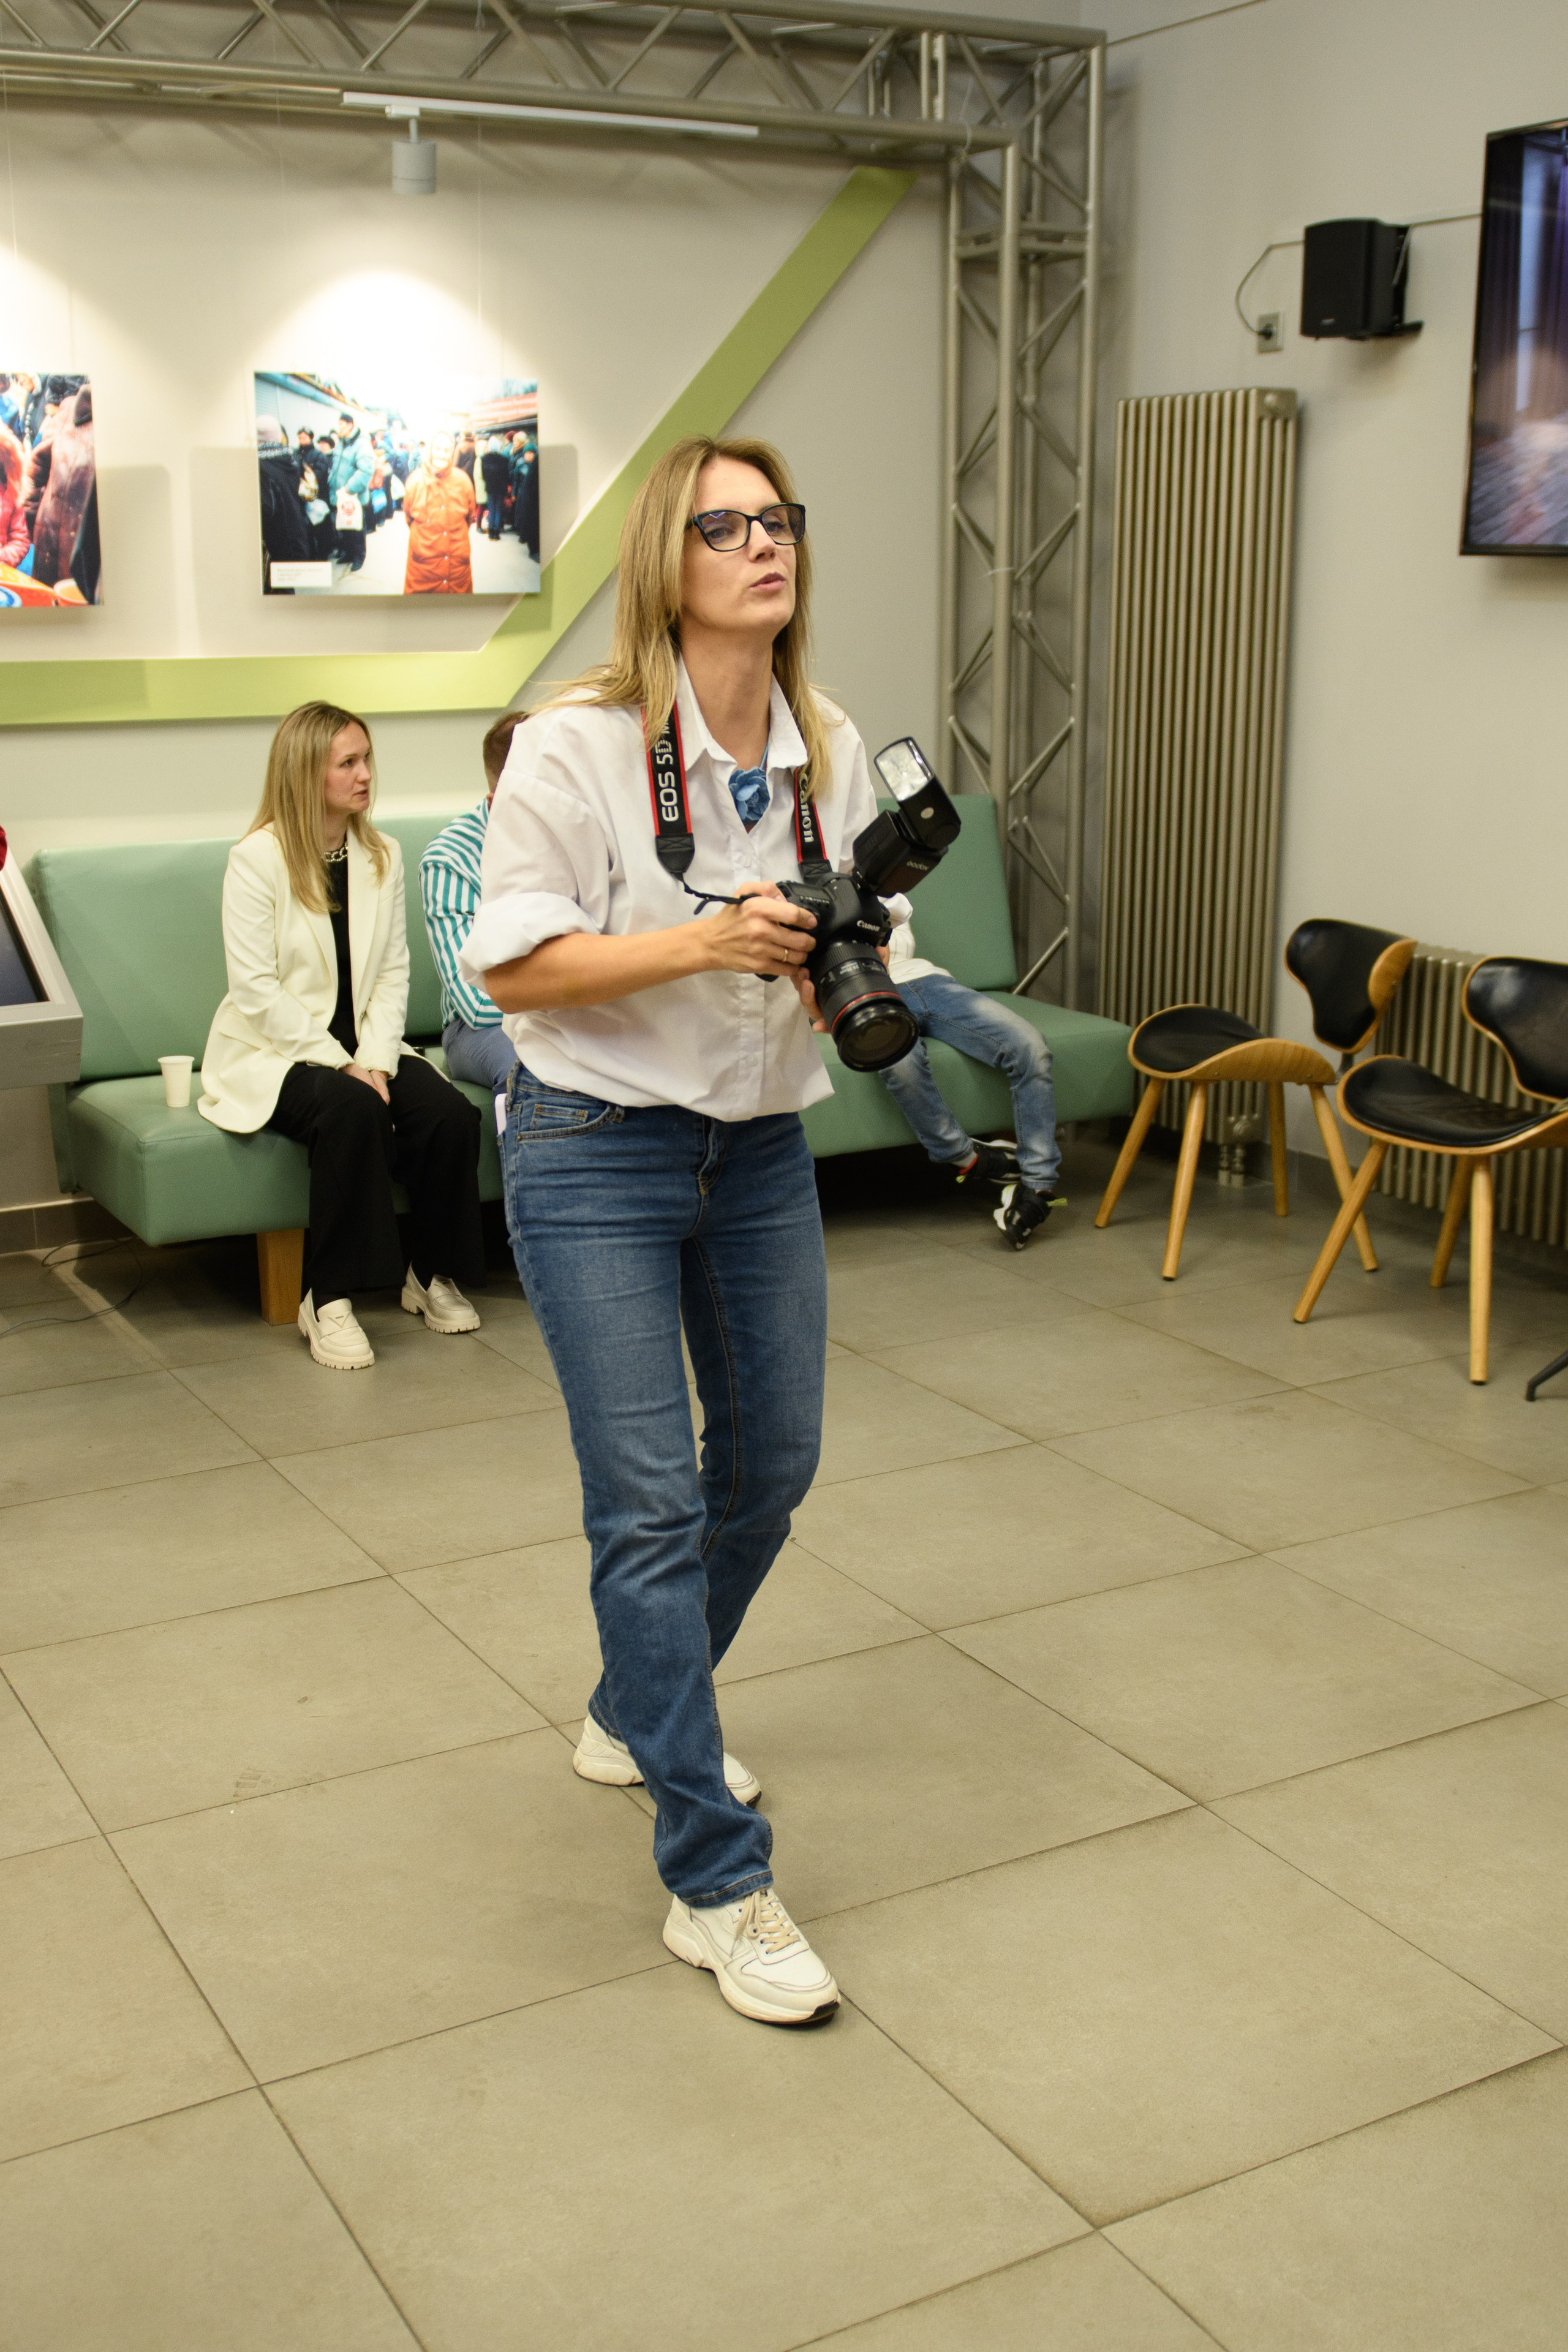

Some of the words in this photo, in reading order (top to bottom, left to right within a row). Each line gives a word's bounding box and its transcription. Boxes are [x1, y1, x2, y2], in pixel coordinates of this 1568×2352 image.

[655, 739, 674, 765] 5D
[658, 772, 679, 821] EOS
[799, 773, 814, 843] Canon
[856, 920, 880, 932] Canon
